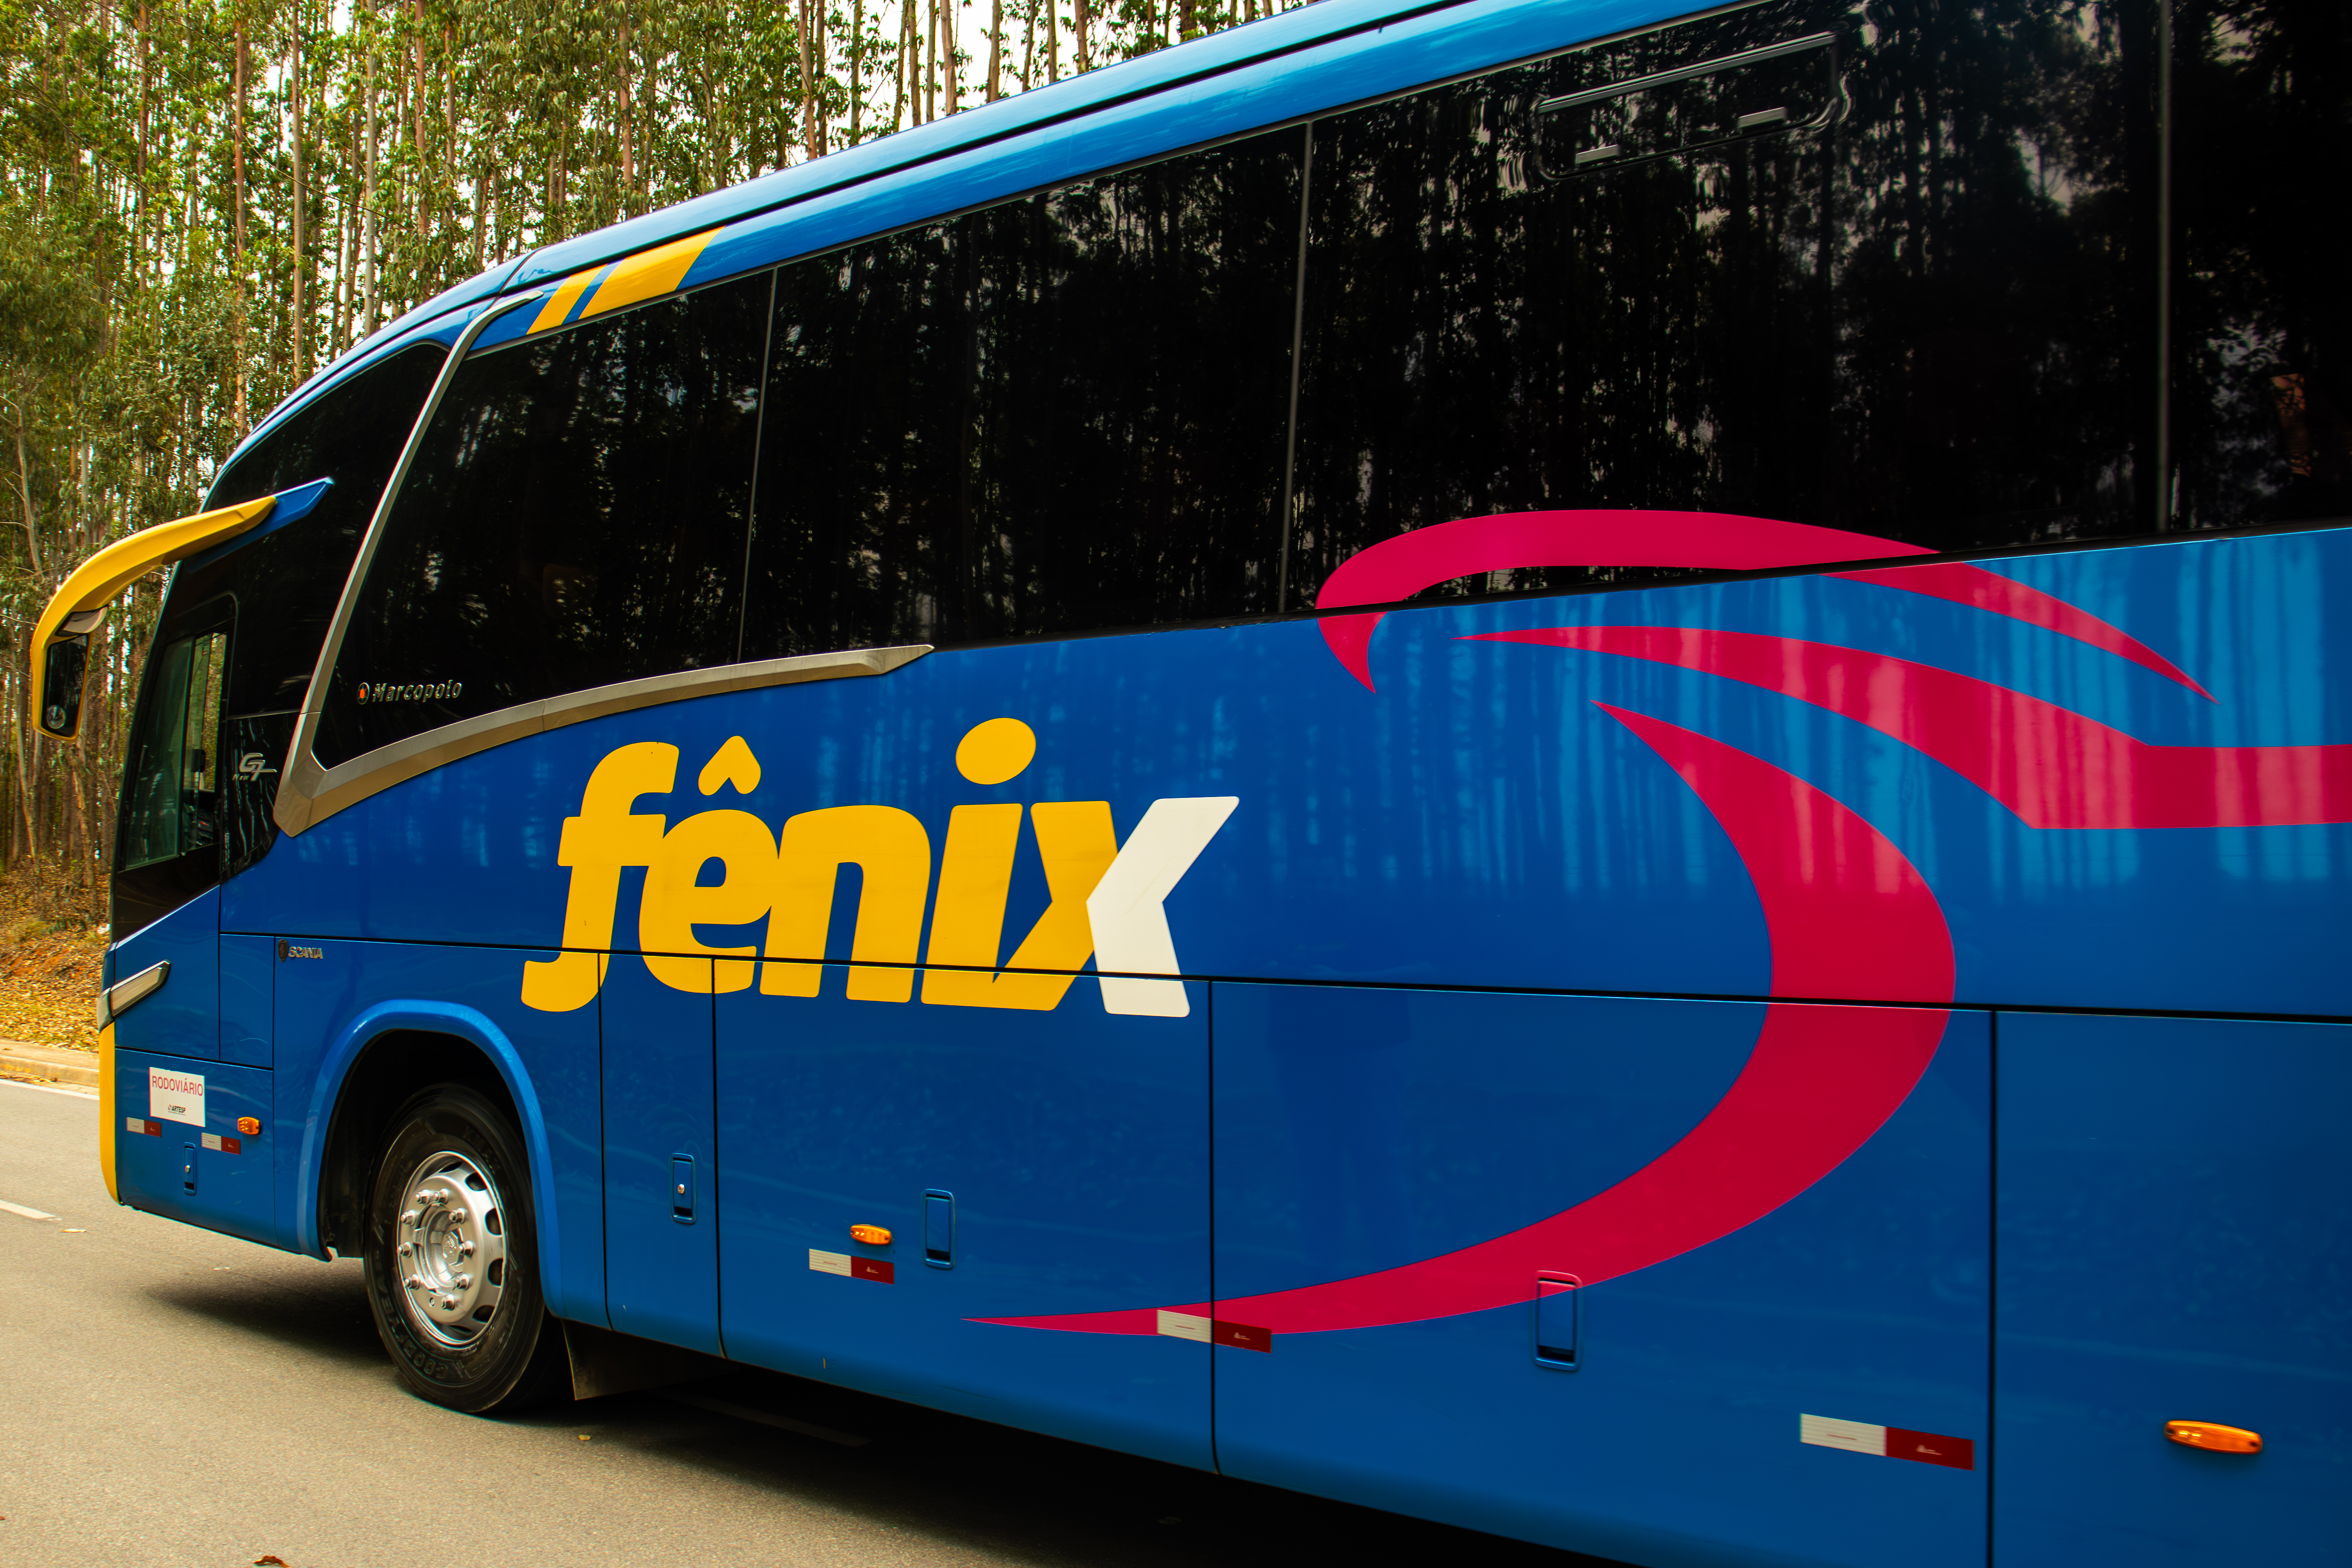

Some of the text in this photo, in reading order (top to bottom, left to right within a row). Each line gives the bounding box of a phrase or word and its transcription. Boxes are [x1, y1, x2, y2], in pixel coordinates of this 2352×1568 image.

[372, 679, 462, 702] Marcopolo
[521, 718, 1239, 1017] fênix
[288, 946, 323, 959] SCANIA
[152, 1075, 203, 1096] RODOVIÁRIO
